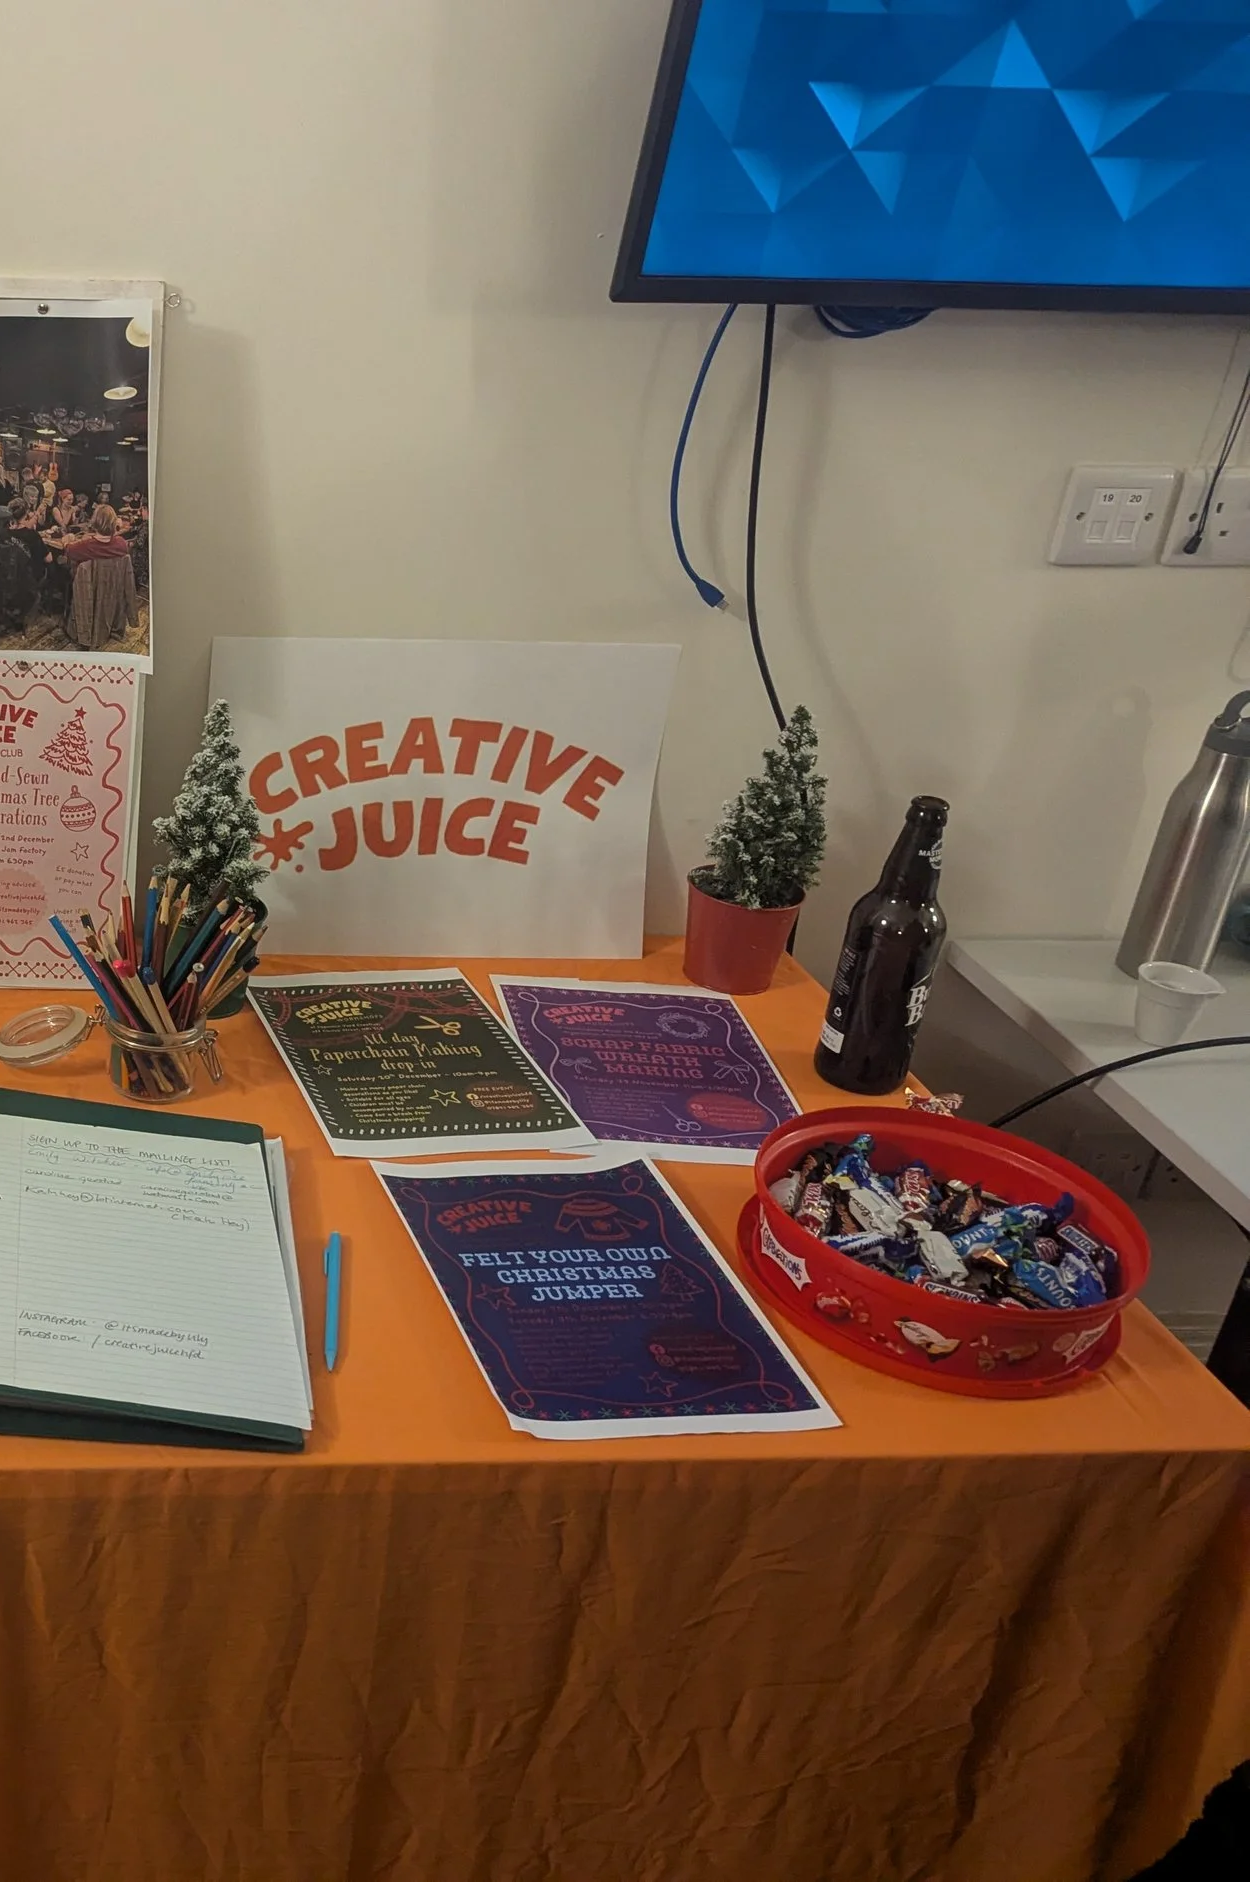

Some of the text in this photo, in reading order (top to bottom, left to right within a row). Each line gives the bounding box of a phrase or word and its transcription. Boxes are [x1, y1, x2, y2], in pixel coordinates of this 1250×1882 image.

[1102, 494, 1142, 503] 19 20
[0, 749, 23, 757] CLUB
[248, 716, 625, 822] CREATIVE
[33, 788, 60, 807] Tree
[17, 835, 55, 843] December
[318, 796, 541, 872] JUICE
[19, 846, 47, 857] Factory
[295, 999, 372, 1019] CREATIVE
[318, 1007, 363, 1024] JUICE
[543, 1005, 626, 1018] CREATIVE
[566, 1013, 614, 1025] JUICE
[363, 1032, 420, 1046] All day
[560, 1037, 726, 1057] SCRAP FABRIC
[309, 1042, 483, 1064] Paperchain Making
[595, 1050, 702, 1067] WREATH
[380, 1059, 437, 1073] drop-in
[605, 1063, 704, 1079] MAKING
[337, 1075, 376, 1083] Saturday
[398, 1072, 442, 1080] December
[28, 1134, 58, 1145] SIGN
[85, 1142, 100, 1151] TO
[105, 1145, 132, 1155] THE
[138, 1151, 194, 1165] MAILING
[436, 1199, 533, 1226] CREATIVE
[465, 1211, 523, 1233] JUICE
[458, 1246, 672, 1267] FELT YOUR OWN
[497, 1265, 657, 1284] CHRISTMAS
[531, 1283, 644, 1301] JUMPER
[17, 1327, 81, 1342] FACEBOOK
